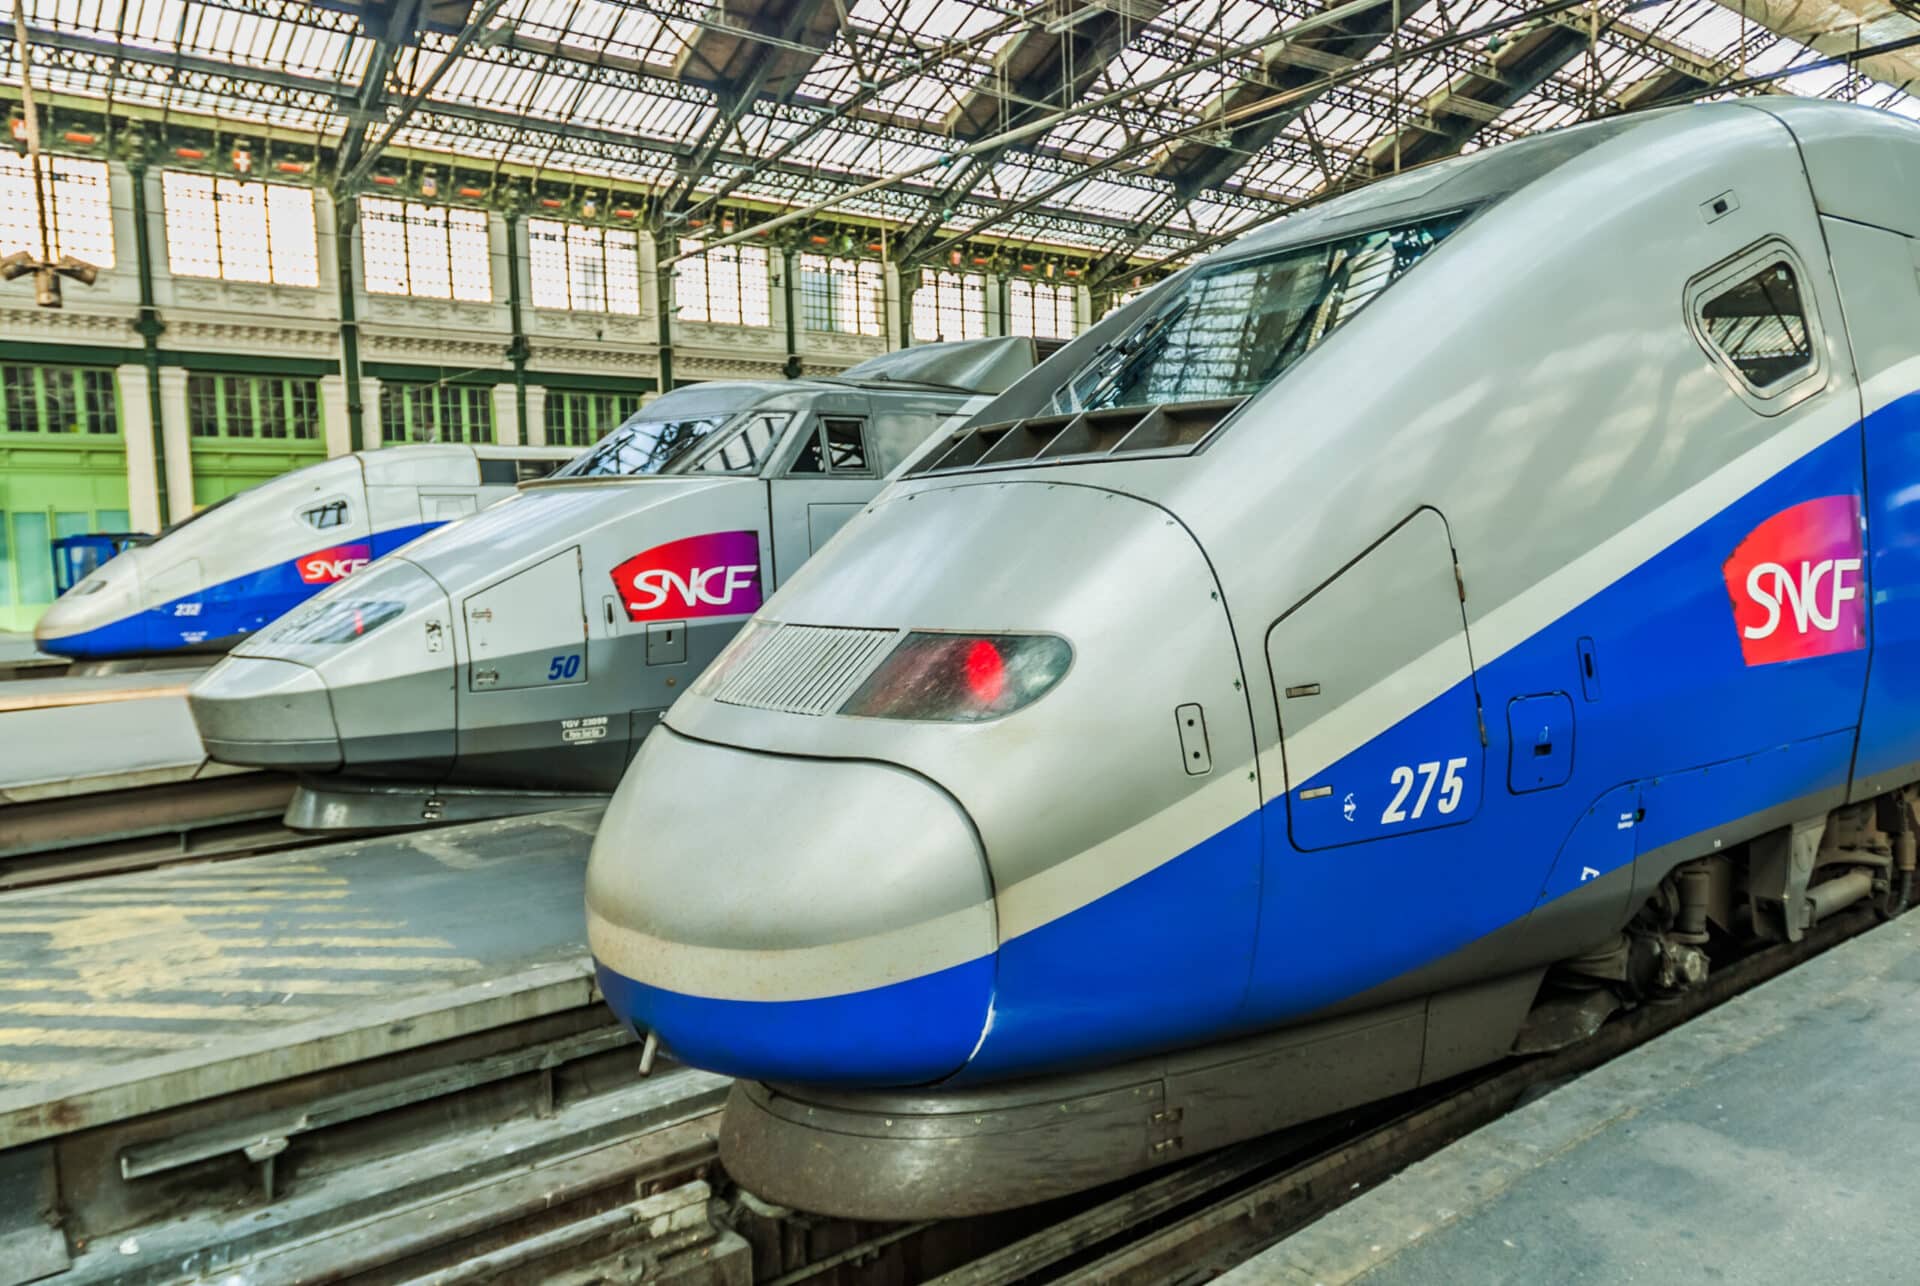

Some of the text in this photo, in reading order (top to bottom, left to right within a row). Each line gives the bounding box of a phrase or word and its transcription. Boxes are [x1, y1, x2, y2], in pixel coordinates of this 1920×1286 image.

[305, 559, 369, 579] SNCF
[629, 565, 758, 610] SNCF
[1744, 558, 1861, 640] SNCF
[548, 655, 580, 680] 50
[561, 719, 580, 728] TGV
[1381, 757, 1467, 825] 275
